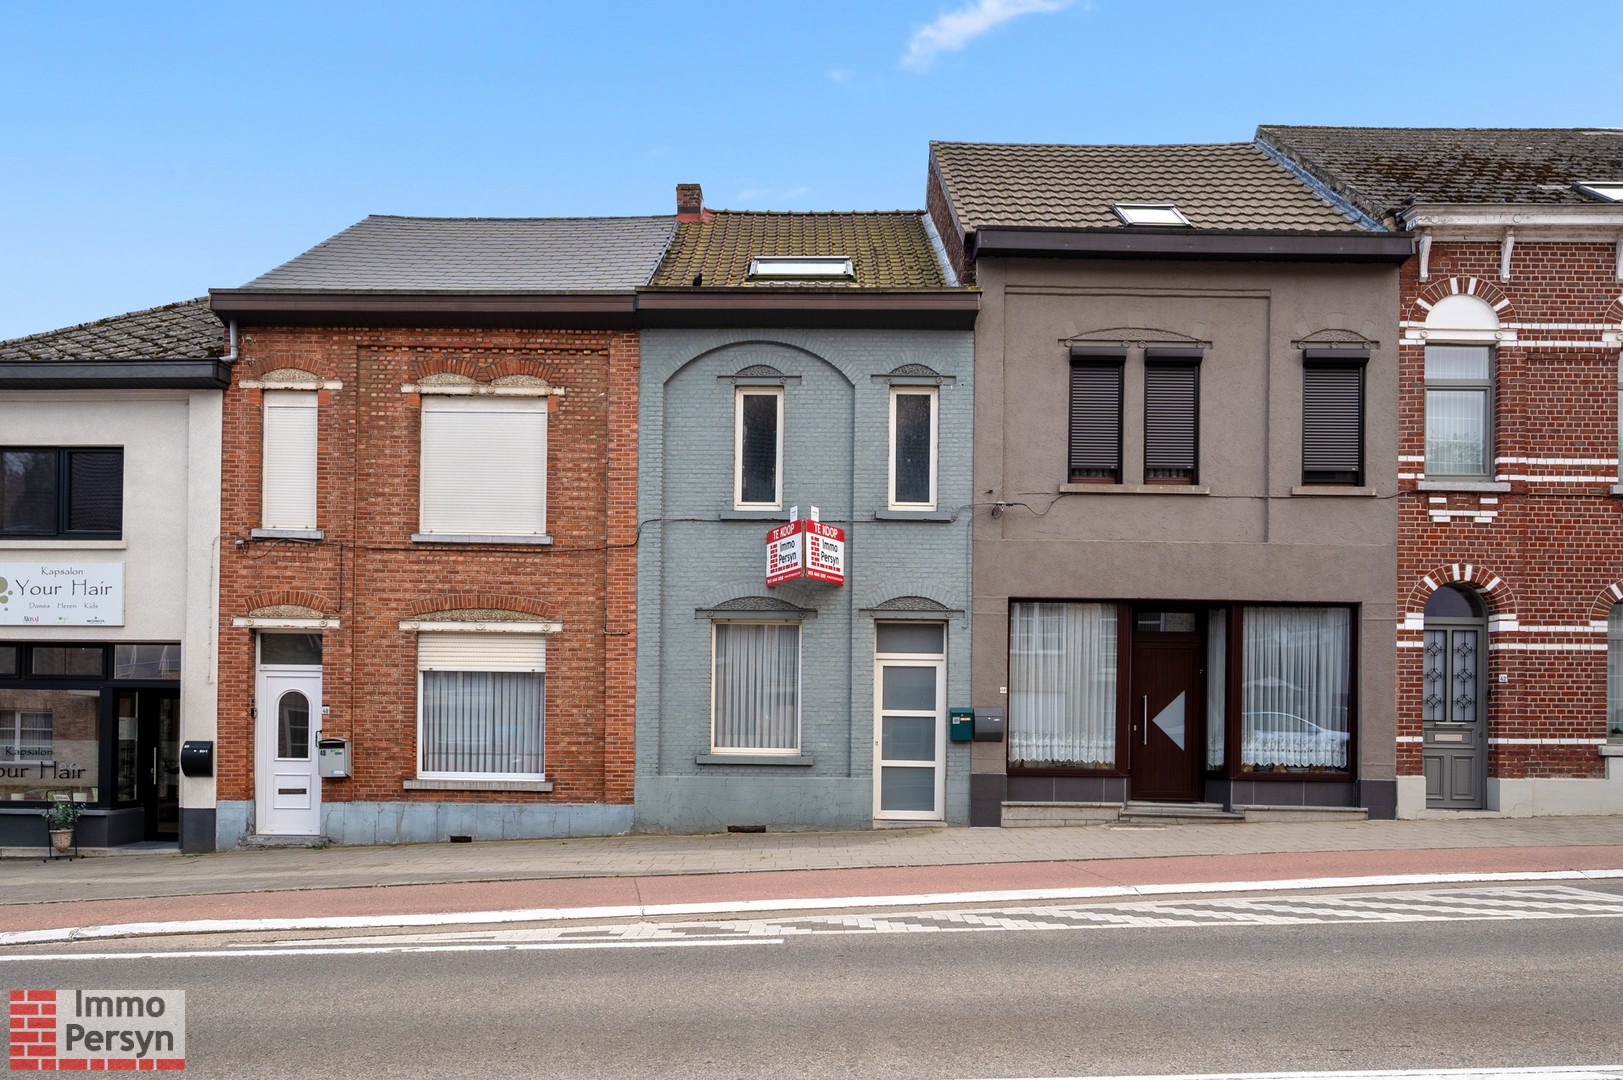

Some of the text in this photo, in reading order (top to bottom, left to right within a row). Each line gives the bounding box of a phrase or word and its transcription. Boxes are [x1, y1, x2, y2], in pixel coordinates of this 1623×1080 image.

[773, 523, 795, 540] TE KOOP
[814, 523, 838, 538] TE KOOP
[780, 540, 795, 552] Immo
[822, 539, 838, 553] Immo
[779, 552, 796, 564] Persyn
[821, 551, 839, 566] Persyn
[41, 566, 84, 578] Kapsalon
[15, 579, 113, 596] Your Hair
[5, 746, 54, 758] Kapsalon
[40, 761, 87, 779] Hair
